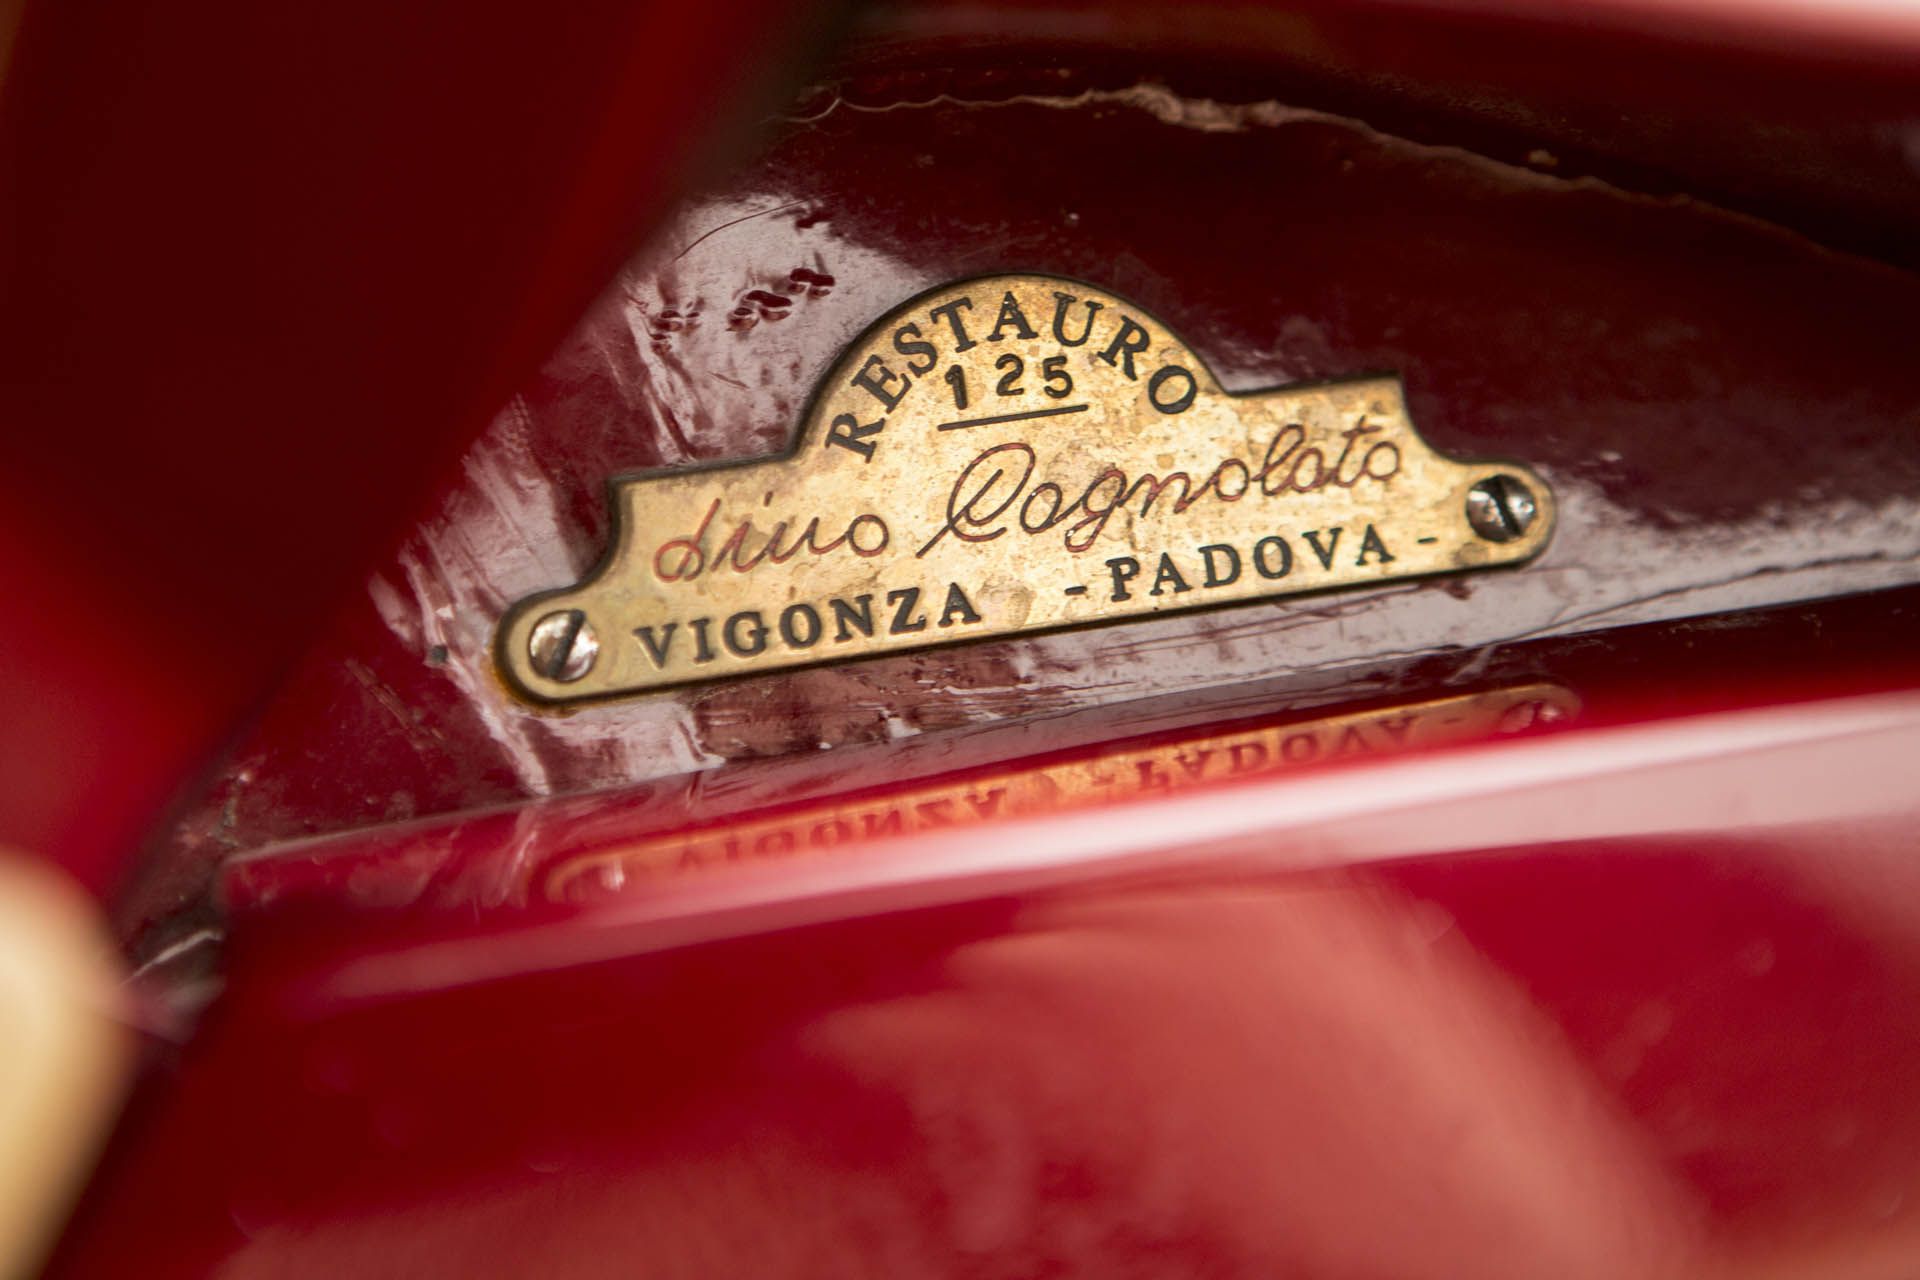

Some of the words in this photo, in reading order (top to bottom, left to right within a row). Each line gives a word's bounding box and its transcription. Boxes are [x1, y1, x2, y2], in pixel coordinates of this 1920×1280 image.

[825, 290, 1197, 463] RESTAURO
[945, 352, 1075, 411] 125
[632, 582, 982, 669] VIGONZA
